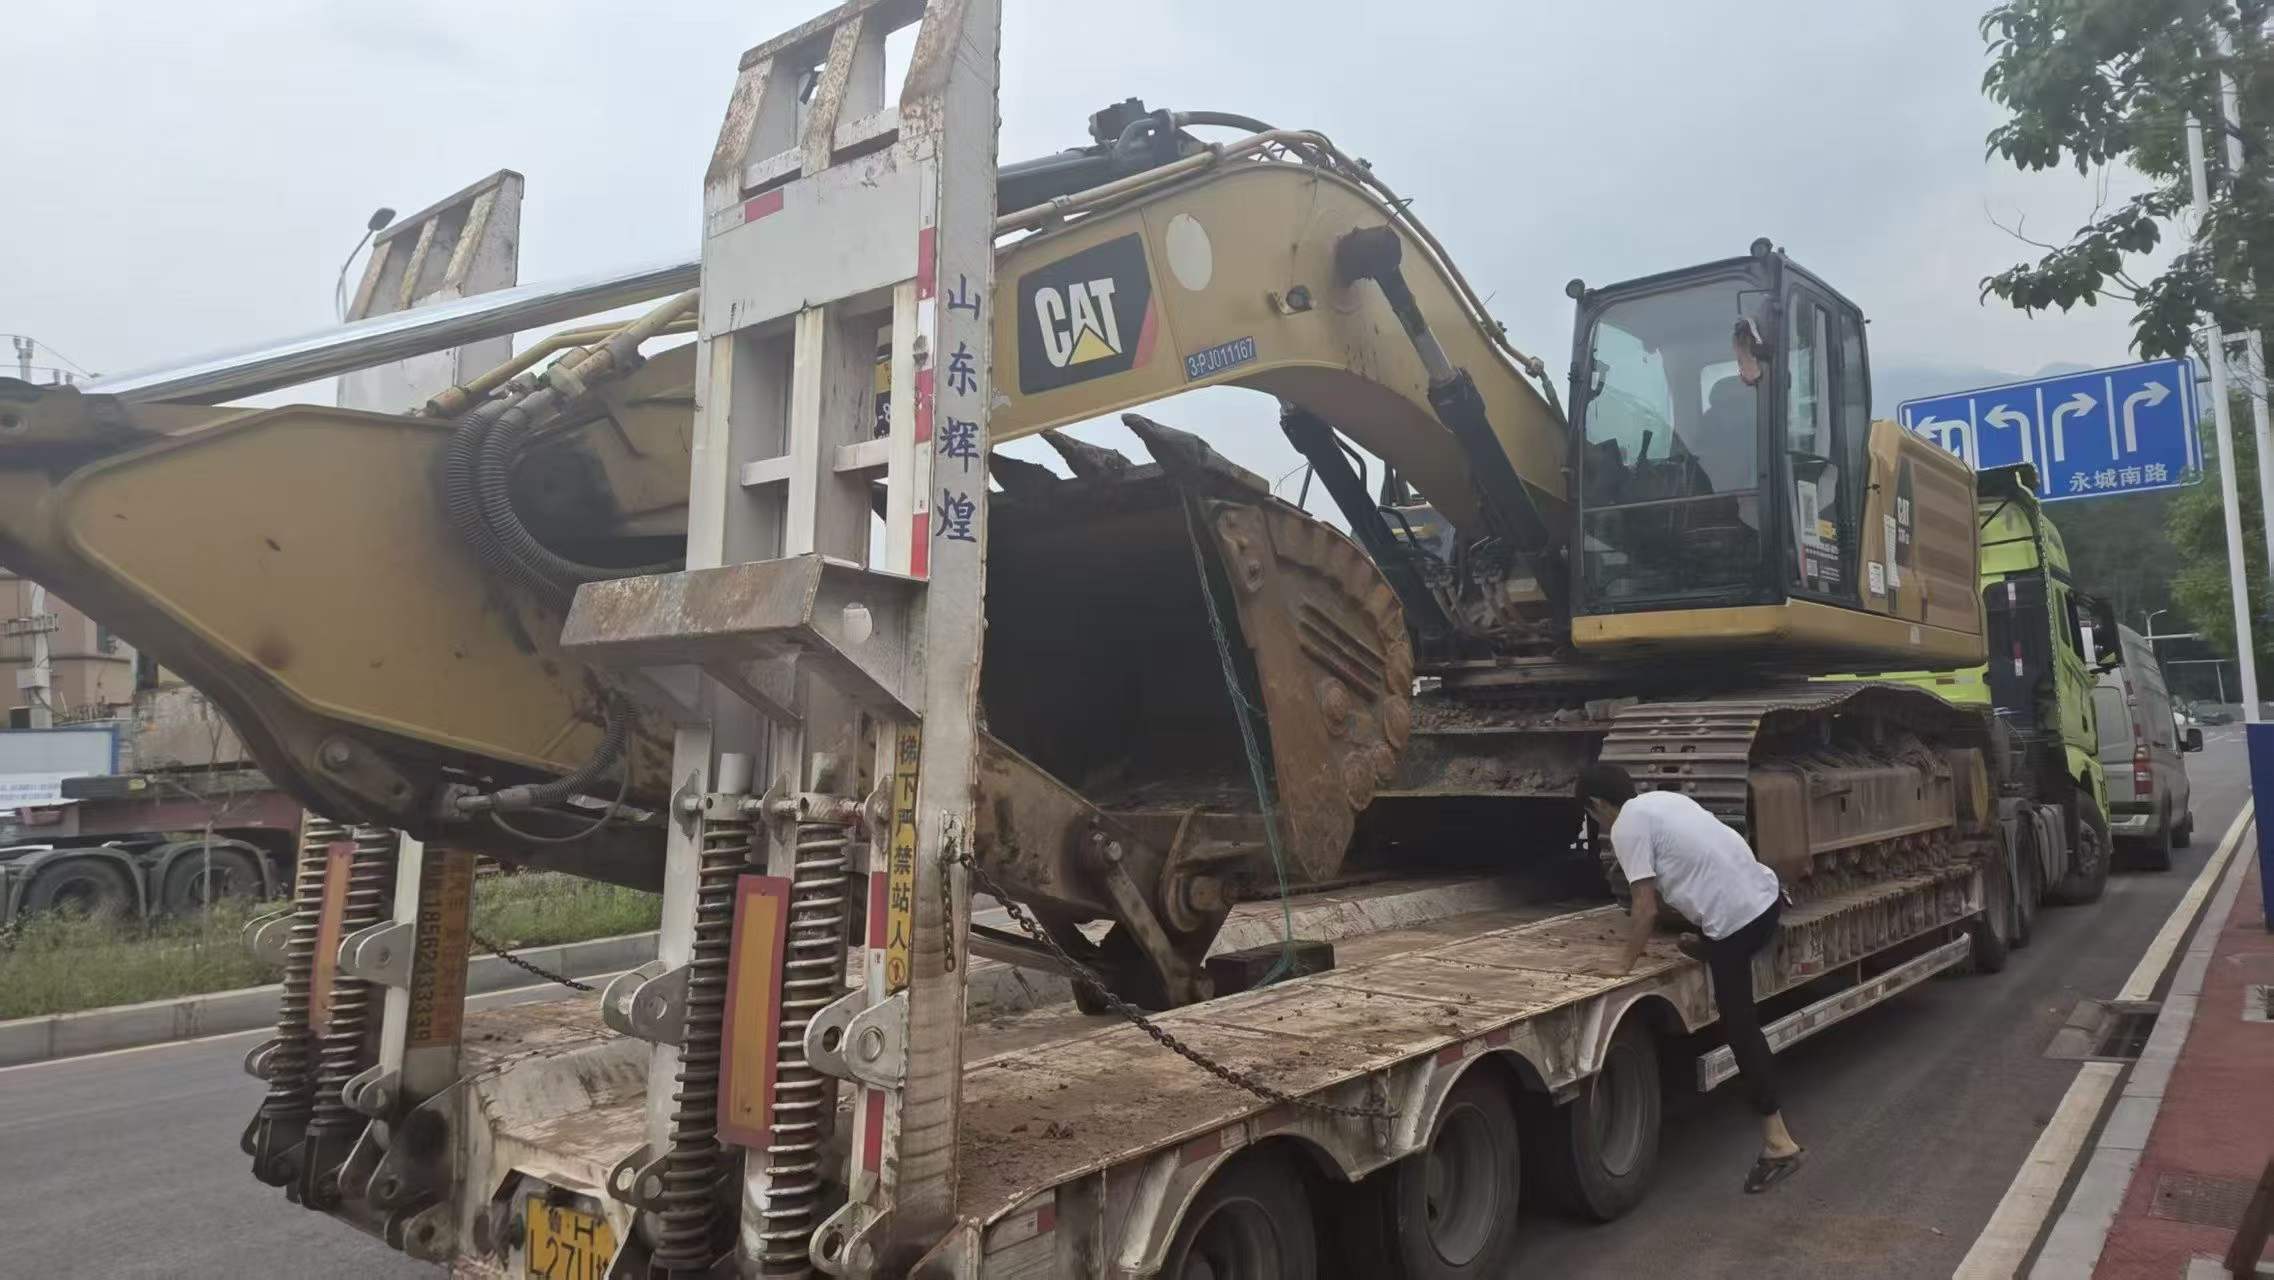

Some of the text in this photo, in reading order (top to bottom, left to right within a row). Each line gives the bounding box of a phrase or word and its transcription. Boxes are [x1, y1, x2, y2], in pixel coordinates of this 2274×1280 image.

[1034, 277, 1123, 368] CAT
[936, 272, 981, 543] 山东辉煌
[2069, 462, 2169, 493] 永城南路
